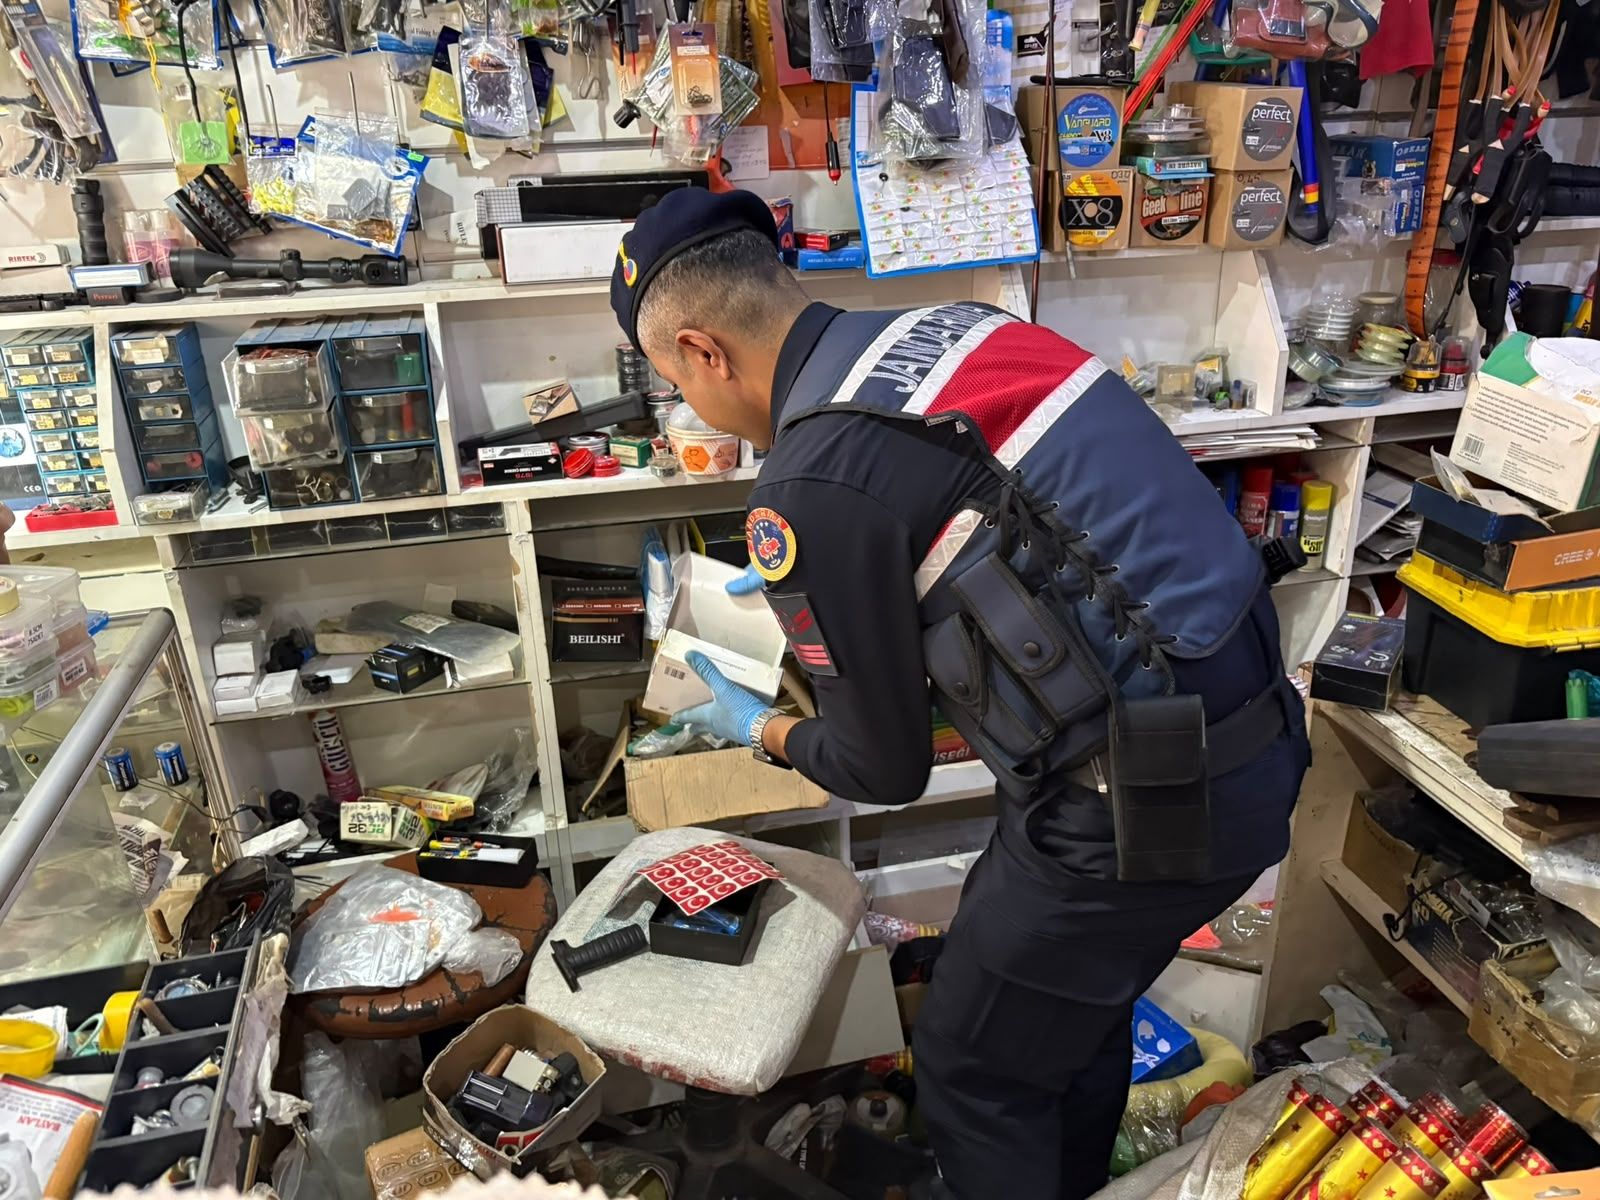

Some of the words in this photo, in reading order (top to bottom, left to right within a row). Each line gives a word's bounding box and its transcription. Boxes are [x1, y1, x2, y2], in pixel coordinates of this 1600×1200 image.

[1251, 105, 1292, 123] perfect
[1142, 195, 1167, 218] Geek
[1179, 190, 1203, 211] line
[1240, 188, 1282, 206] perfect
[1067, 197, 1114, 226] X8
[569, 634, 622, 644] BEILISHI
[348, 823, 367, 834] 32
[17, 1115, 62, 1132] BAYLAN
